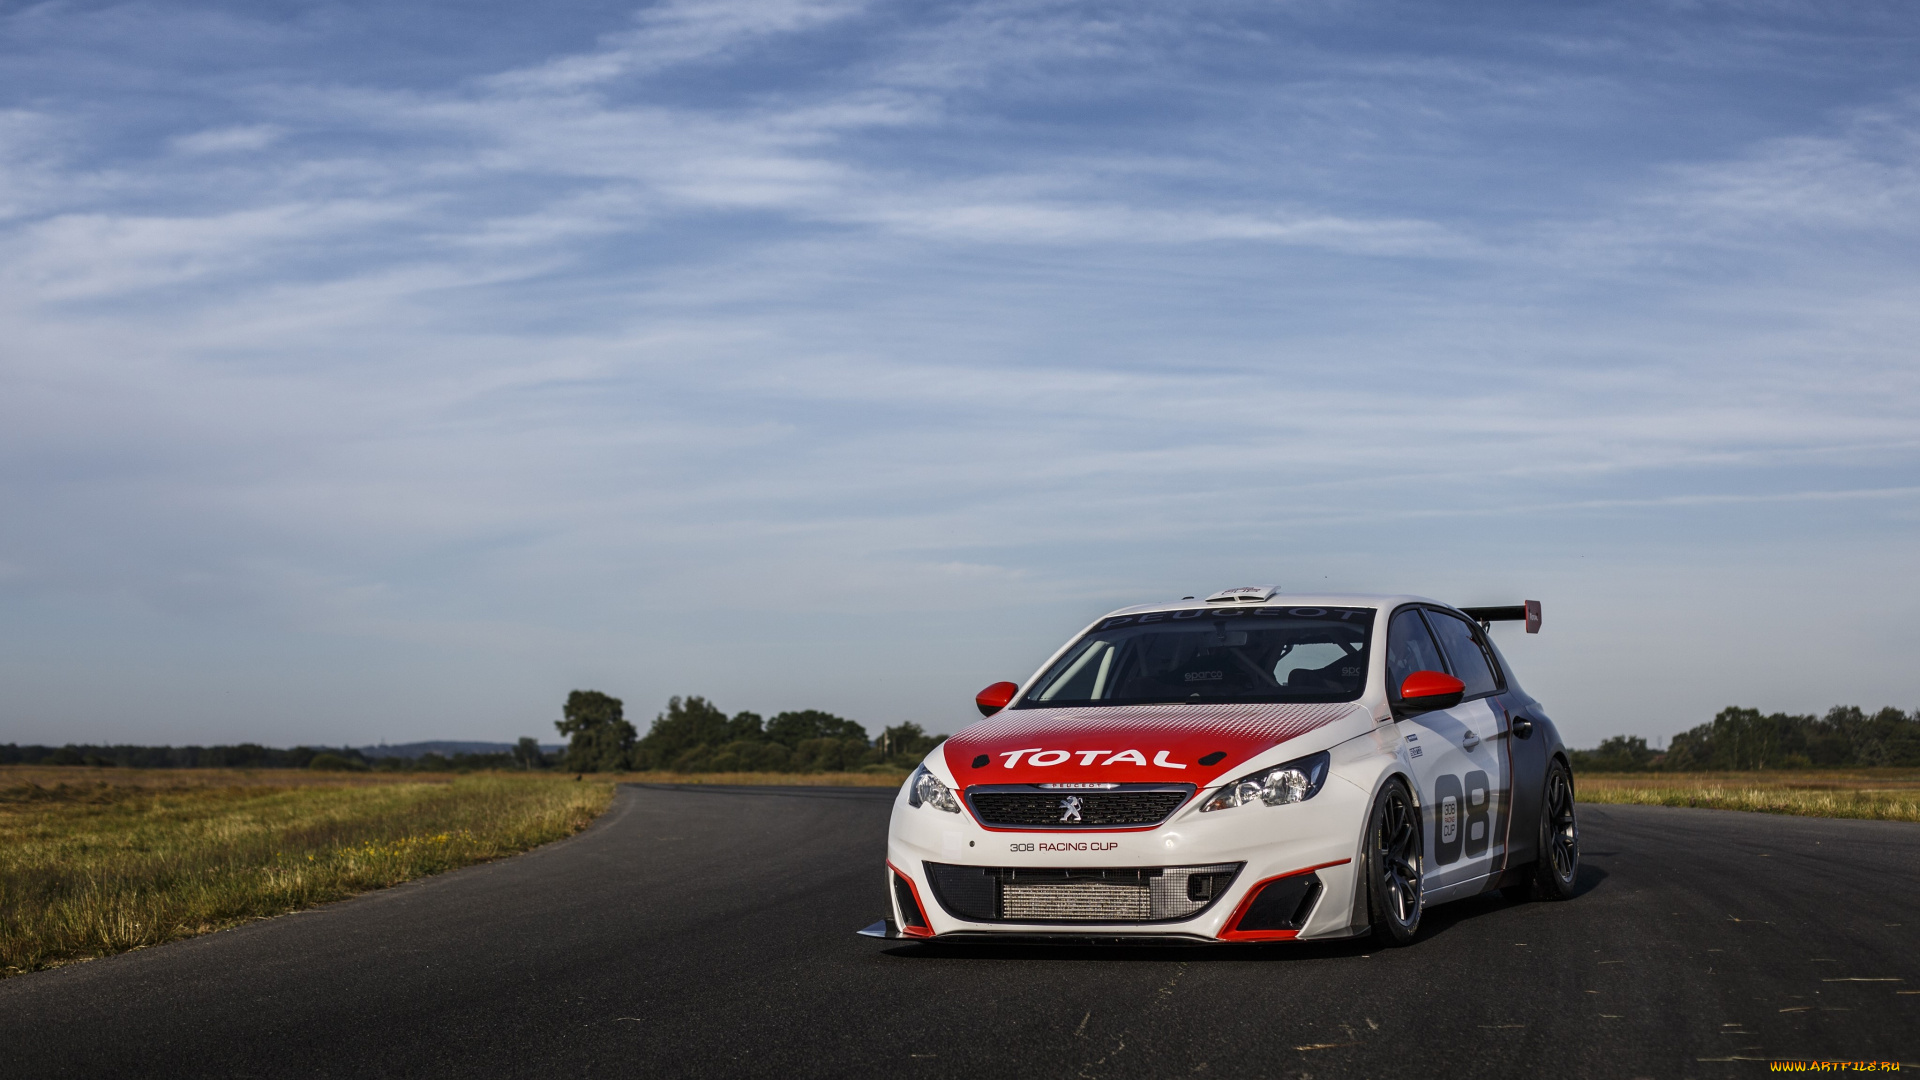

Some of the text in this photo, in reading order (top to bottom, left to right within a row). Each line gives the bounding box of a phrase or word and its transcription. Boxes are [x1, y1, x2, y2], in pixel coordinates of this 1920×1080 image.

[1101, 607, 1367, 630] PEUGEOT
[1184, 670, 1223, 682] sparco
[999, 747, 1187, 770] TOTAL
[1444, 803, 1456, 816] 308
[1434, 770, 1490, 867] 08
[1443, 824, 1456, 837] CUP
[1009, 842, 1118, 852] 308 RACING CUP
